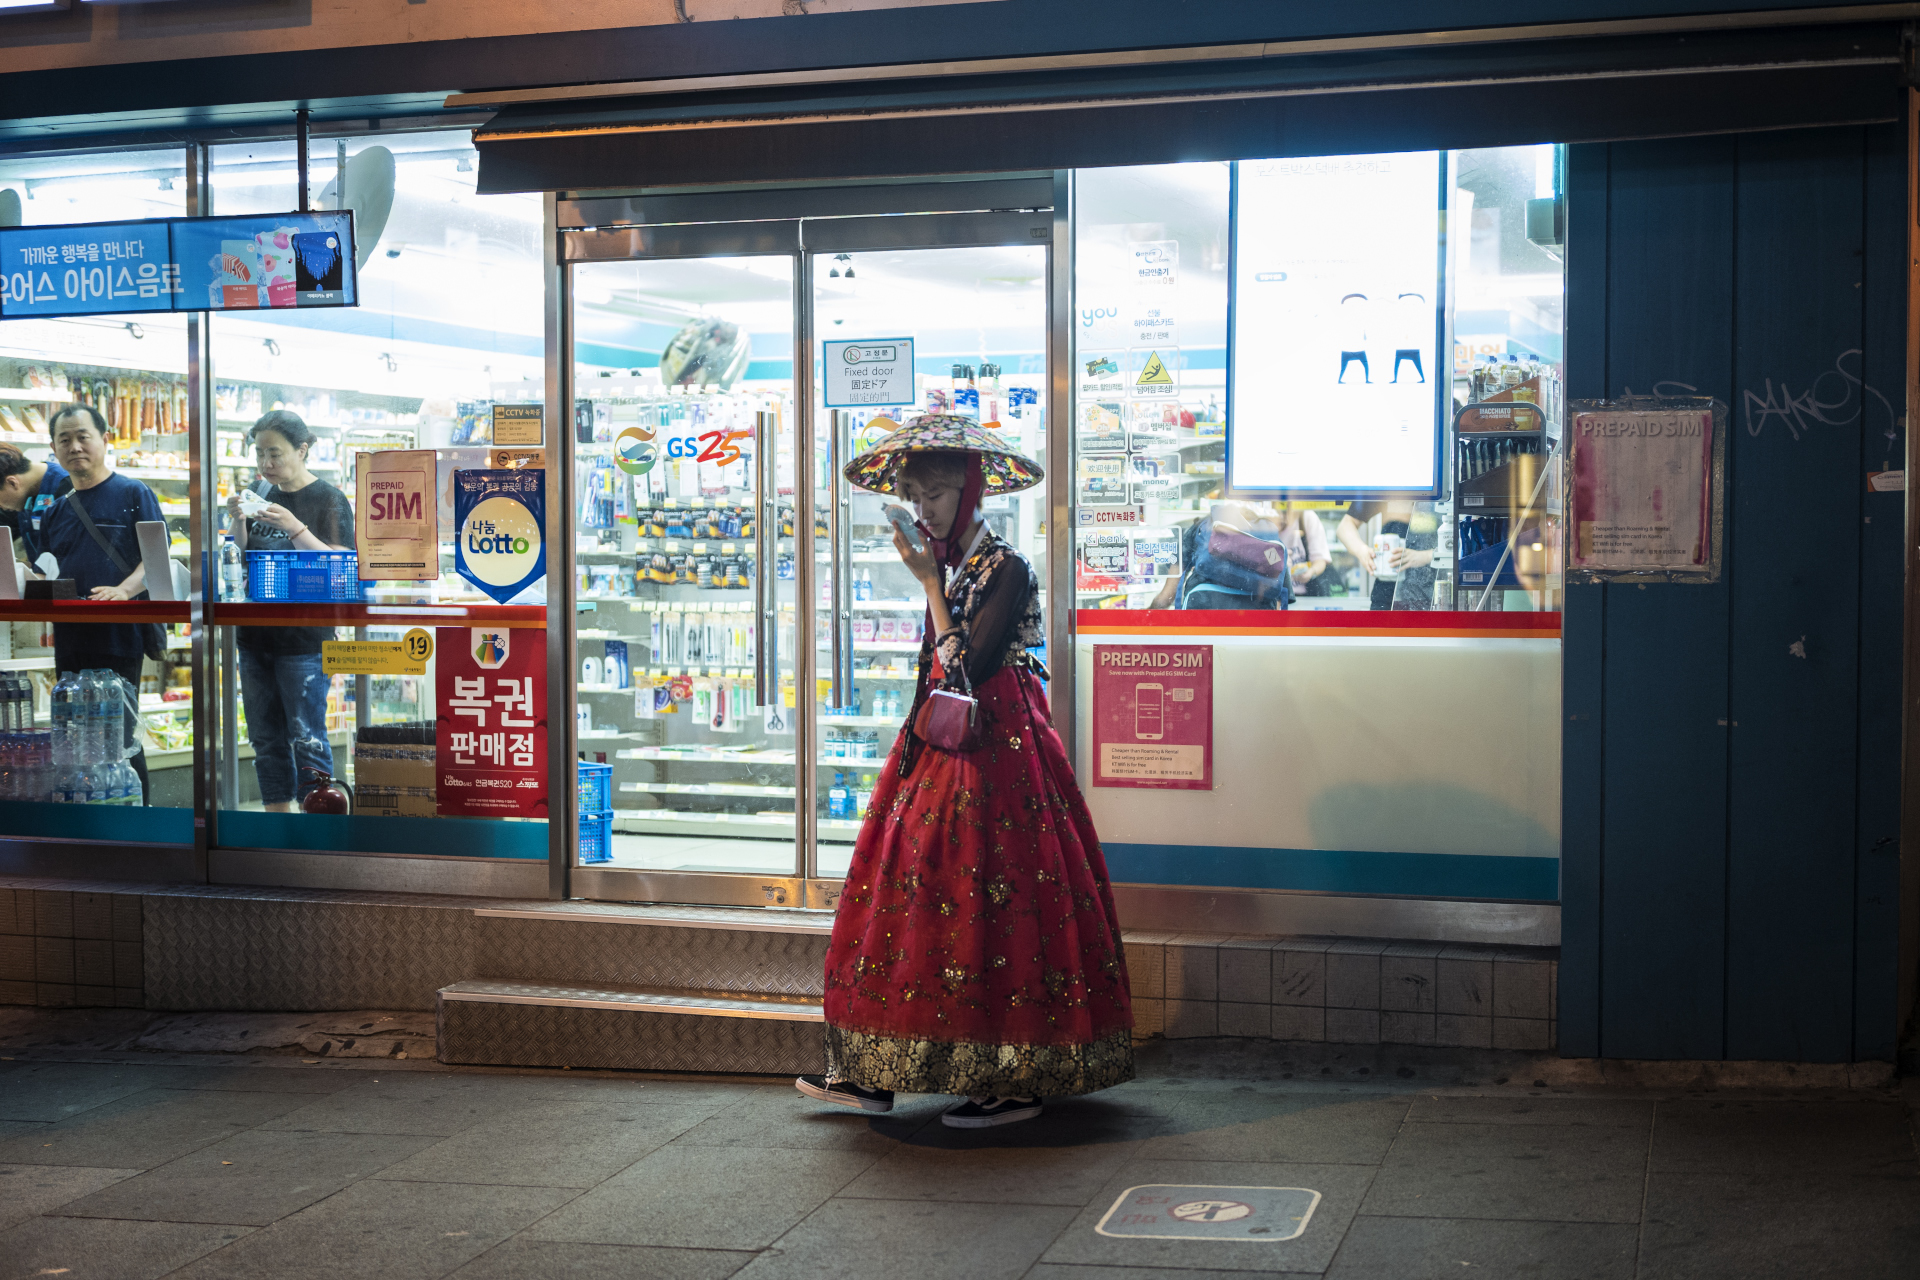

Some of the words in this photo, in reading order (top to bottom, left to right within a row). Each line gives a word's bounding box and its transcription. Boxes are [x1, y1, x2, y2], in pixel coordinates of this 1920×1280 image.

[20, 245, 59, 266] 가까운
[61, 242, 100, 264] 행복을
[102, 240, 144, 261] 만나다
[64, 263, 184, 302] 아이스음료
[1134, 318, 1174, 327] 하이패스카드
[844, 367, 868, 376] Fixed
[872, 366, 894, 375] door
[851, 379, 887, 390] 固定ドア
[1136, 386, 1156, 394] 넘어짐
[1157, 385, 1173, 393] 조심!
[1150, 423, 1172, 431] 멤버십
[1581, 420, 1662, 437] PREPAID
[1665, 420, 1701, 437] SIM
[667, 430, 749, 467] GS25
[1088, 464, 1120, 473] 欢迎使用
[371, 482, 404, 490] PREPAID
[370, 492, 423, 521] SIM
[251, 521, 288, 539] GUES
[472, 520, 496, 535] 나눔
[468, 534, 529, 554] Lotto
[1100, 534, 1126, 543] bank
[1135, 543, 1160, 554] 편의점
[1161, 542, 1177, 554] 택배
[1137, 556, 1169, 564] postbox
[408, 636, 428, 655] 19
[1101, 652, 1170, 668] PREPAID
[1172, 652, 1203, 668] SIM
[449, 676, 534, 728] 복권
[450, 731, 534, 767] 판매점
[475, 779, 512, 788] 연금복권520
